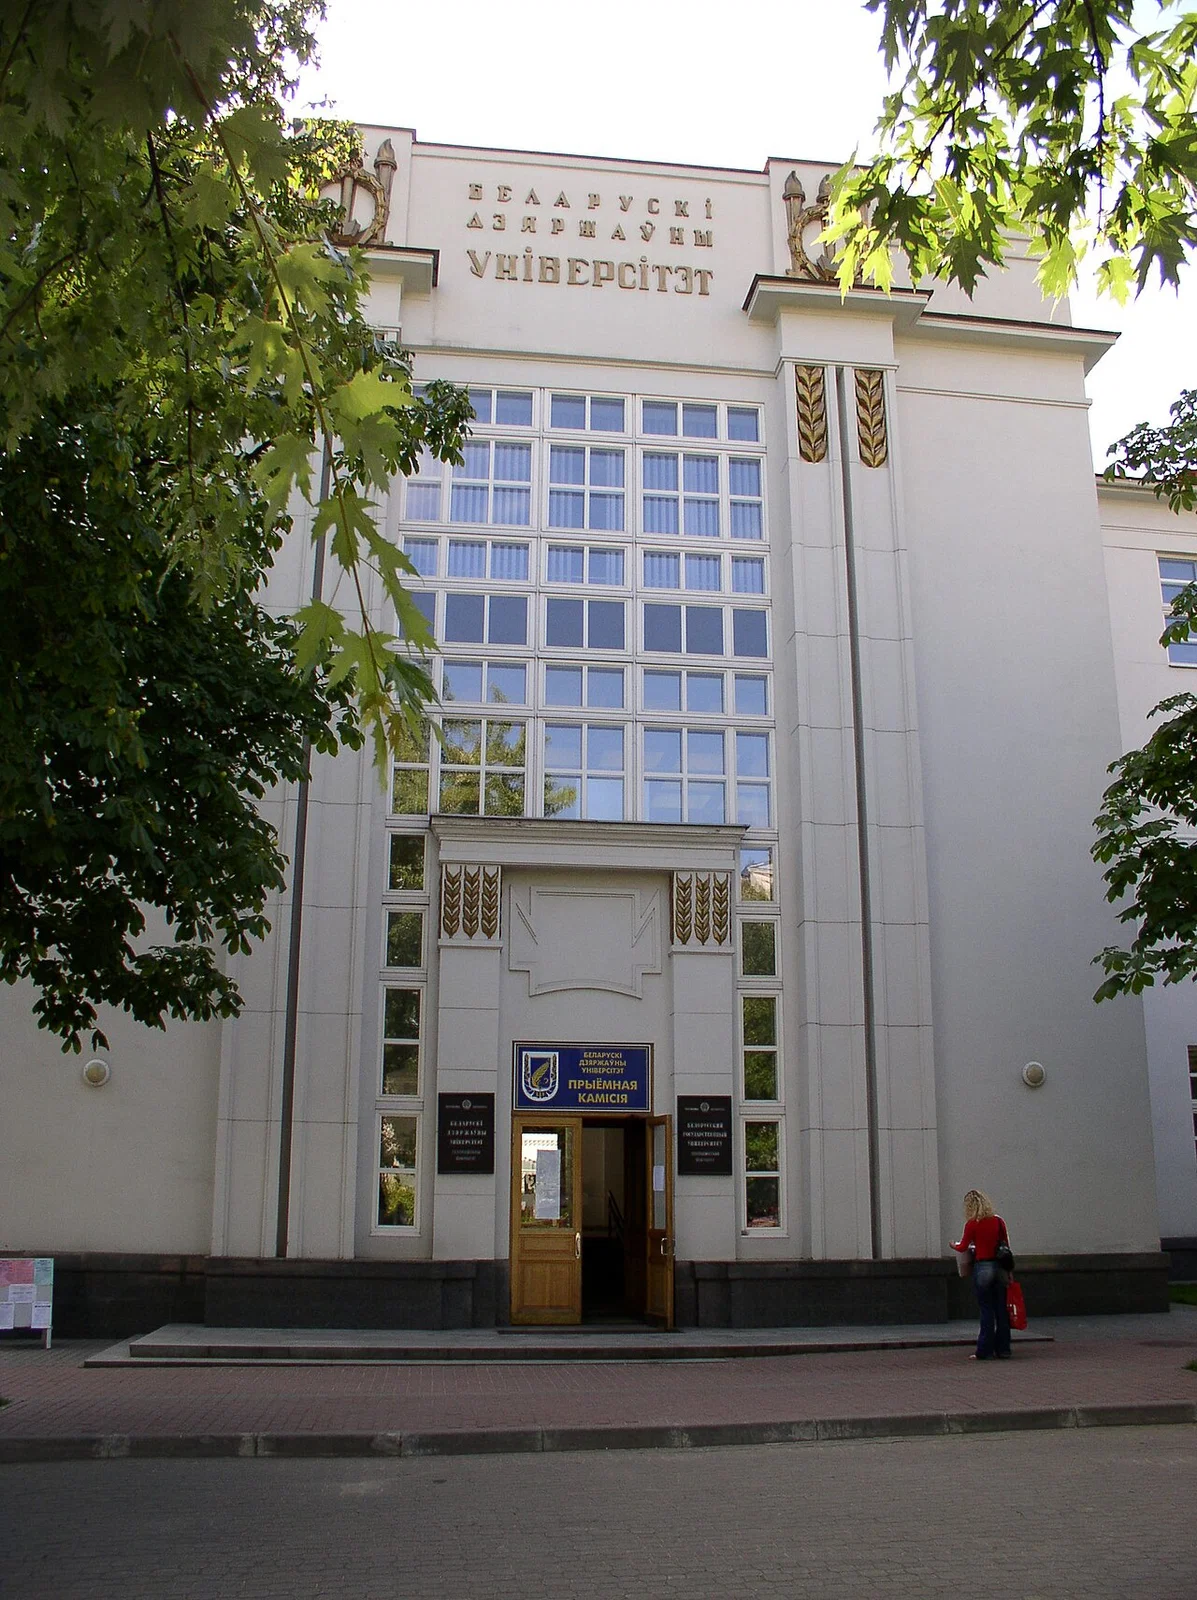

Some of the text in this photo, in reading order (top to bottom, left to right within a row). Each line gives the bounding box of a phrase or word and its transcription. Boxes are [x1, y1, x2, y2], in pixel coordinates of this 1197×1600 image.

[468, 183, 713, 219] БЕЛАРУСКІ
[467, 212, 713, 247] ДЗЯРЖАЎНЫ
[467, 246, 714, 296] УНІВЕРСІТЭТ
[568, 1078, 638, 1090] ПРЫЁМНАЯ
[578, 1093, 628, 1104] КАМІСІЯ
